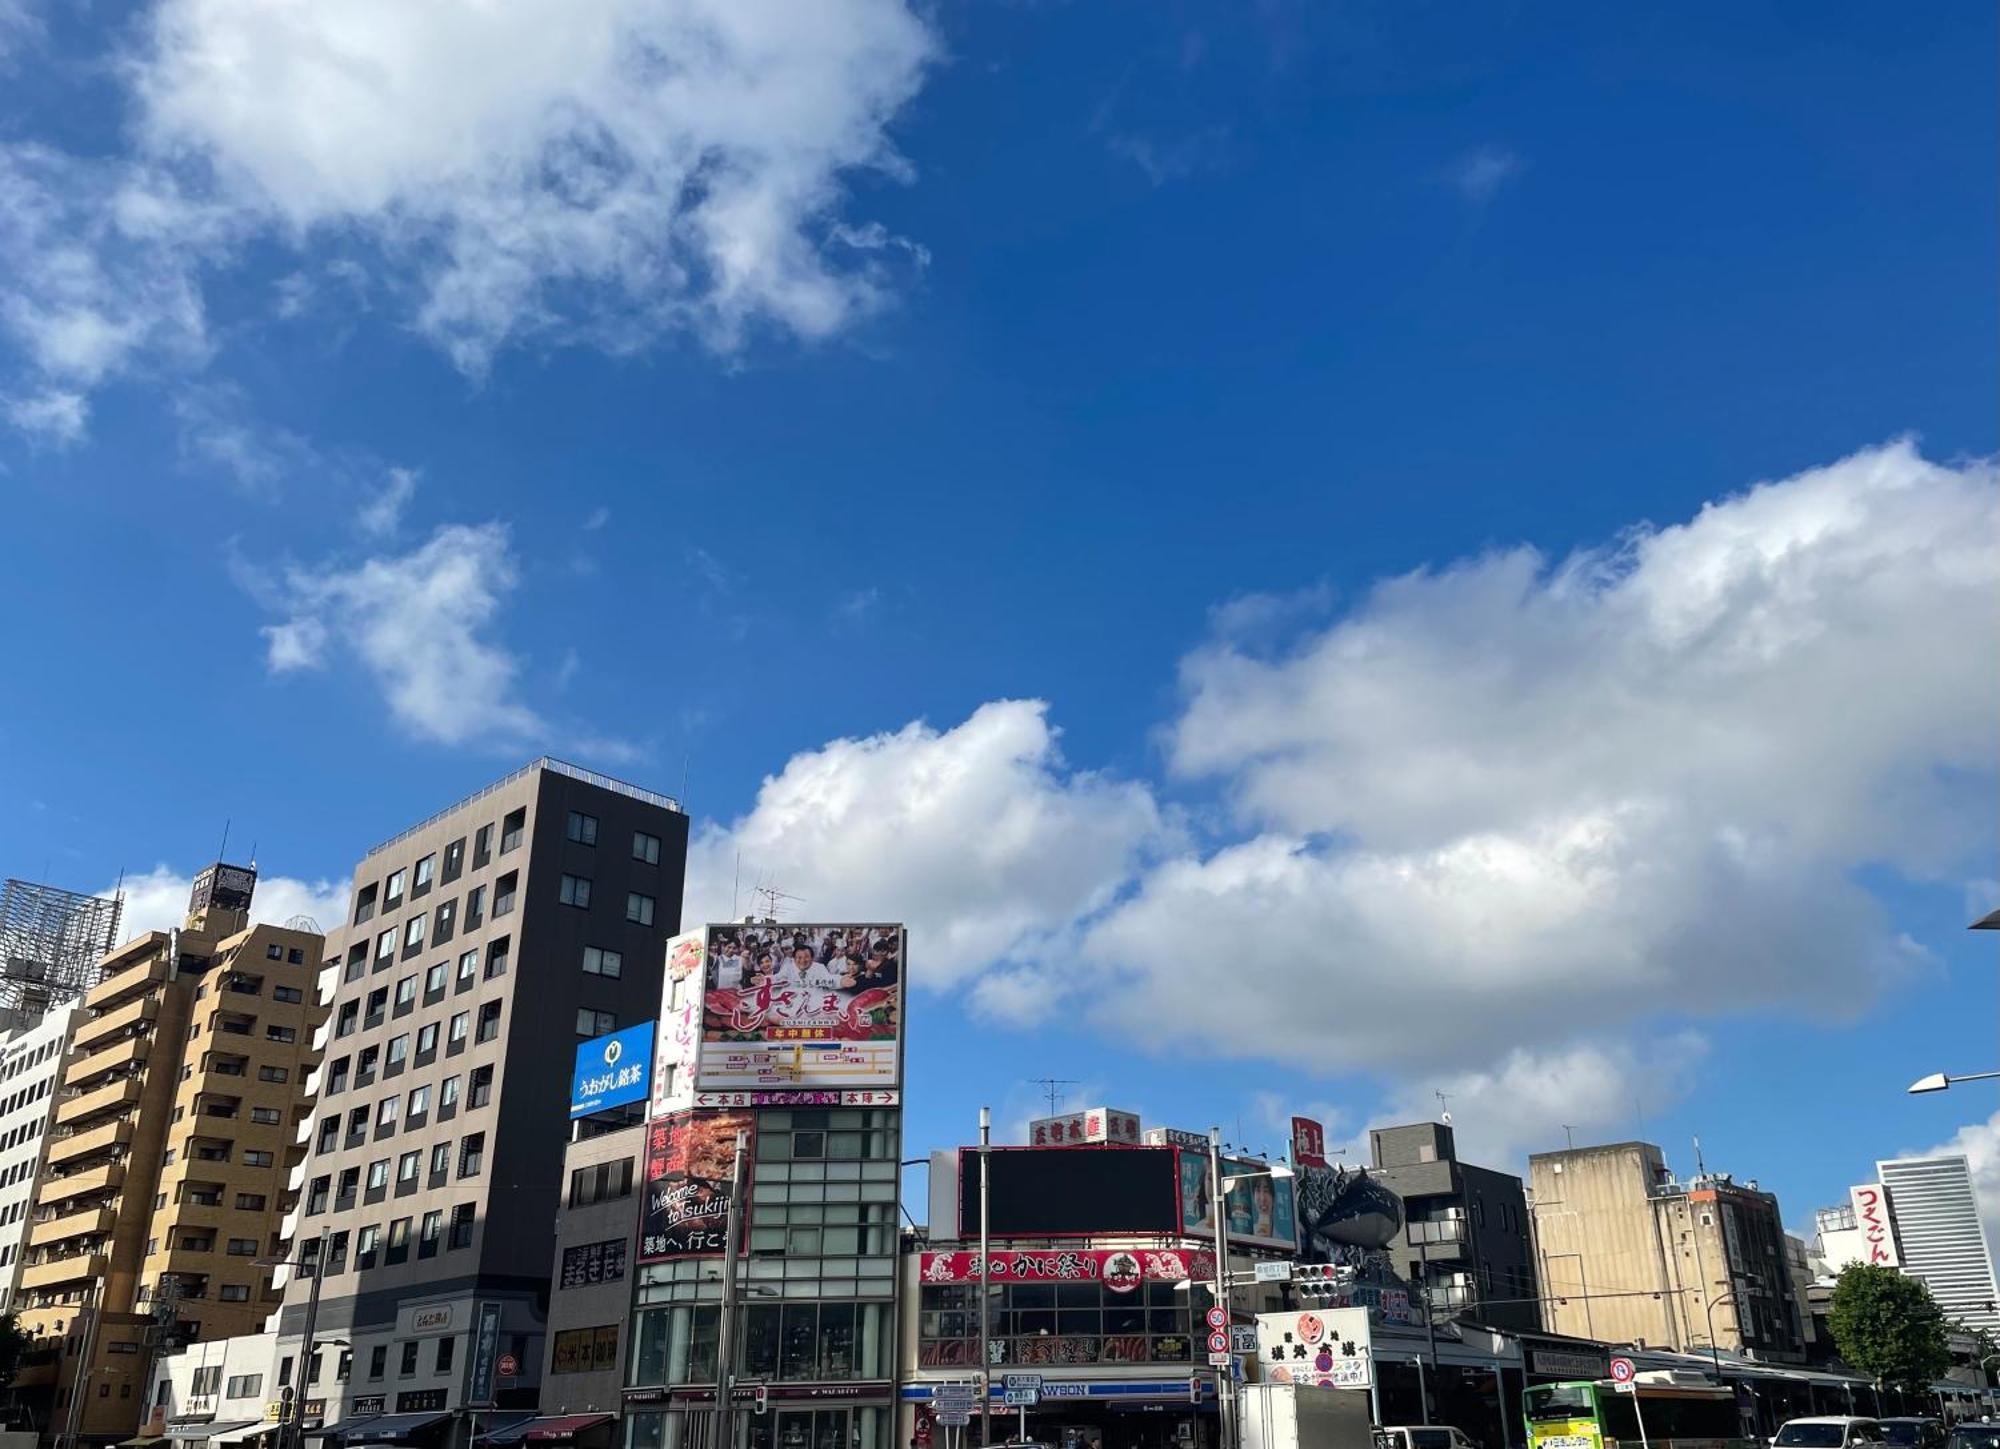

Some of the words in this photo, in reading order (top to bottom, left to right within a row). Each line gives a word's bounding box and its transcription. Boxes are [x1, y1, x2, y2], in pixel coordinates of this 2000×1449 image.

[580, 1064, 642, 1098] うおがし銘茶
[651, 1183, 698, 1211] Welcome
[1857, 1190, 1889, 1263] つくごん
[1211, 1313, 1223, 1323] 50
[1042, 1384, 1087, 1396] AWSON
